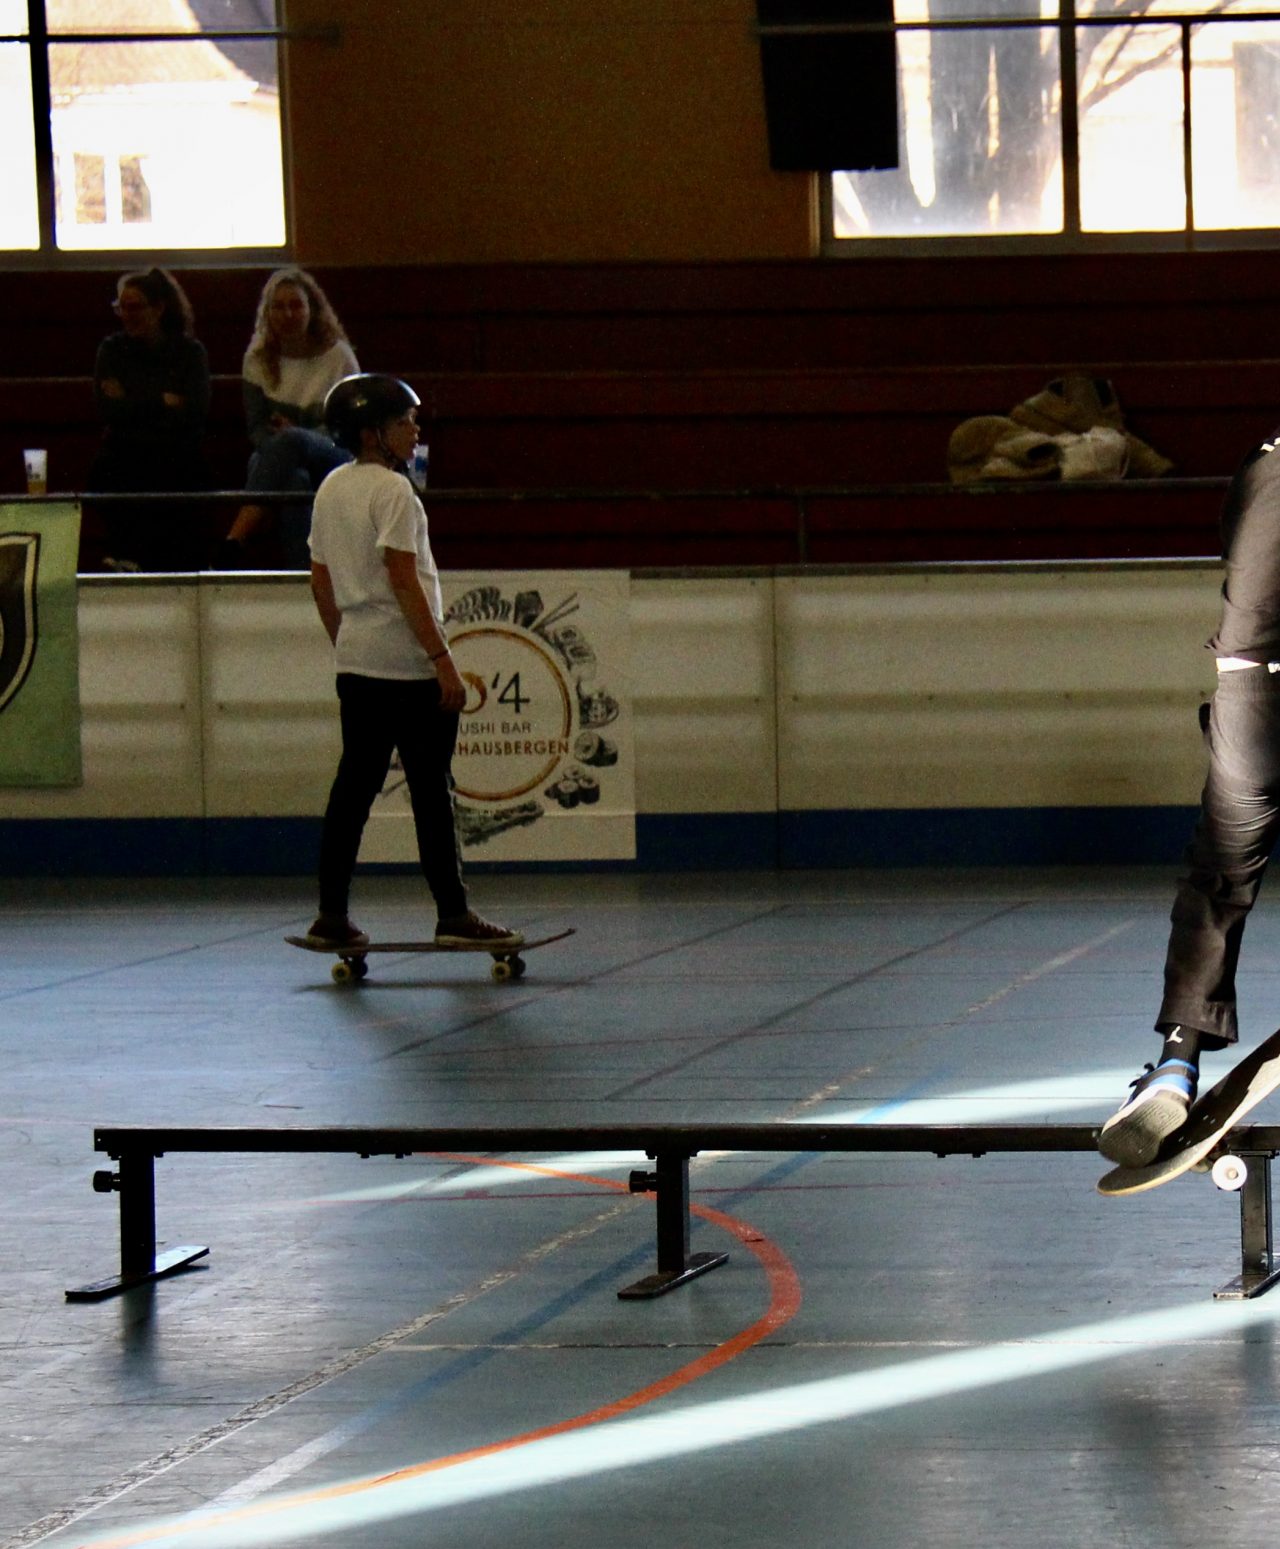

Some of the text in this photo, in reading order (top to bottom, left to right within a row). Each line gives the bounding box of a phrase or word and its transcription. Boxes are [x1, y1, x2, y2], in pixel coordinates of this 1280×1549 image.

[460, 722, 531, 735] USHI BAR
[453, 740, 569, 756] HAUSBERGEN
